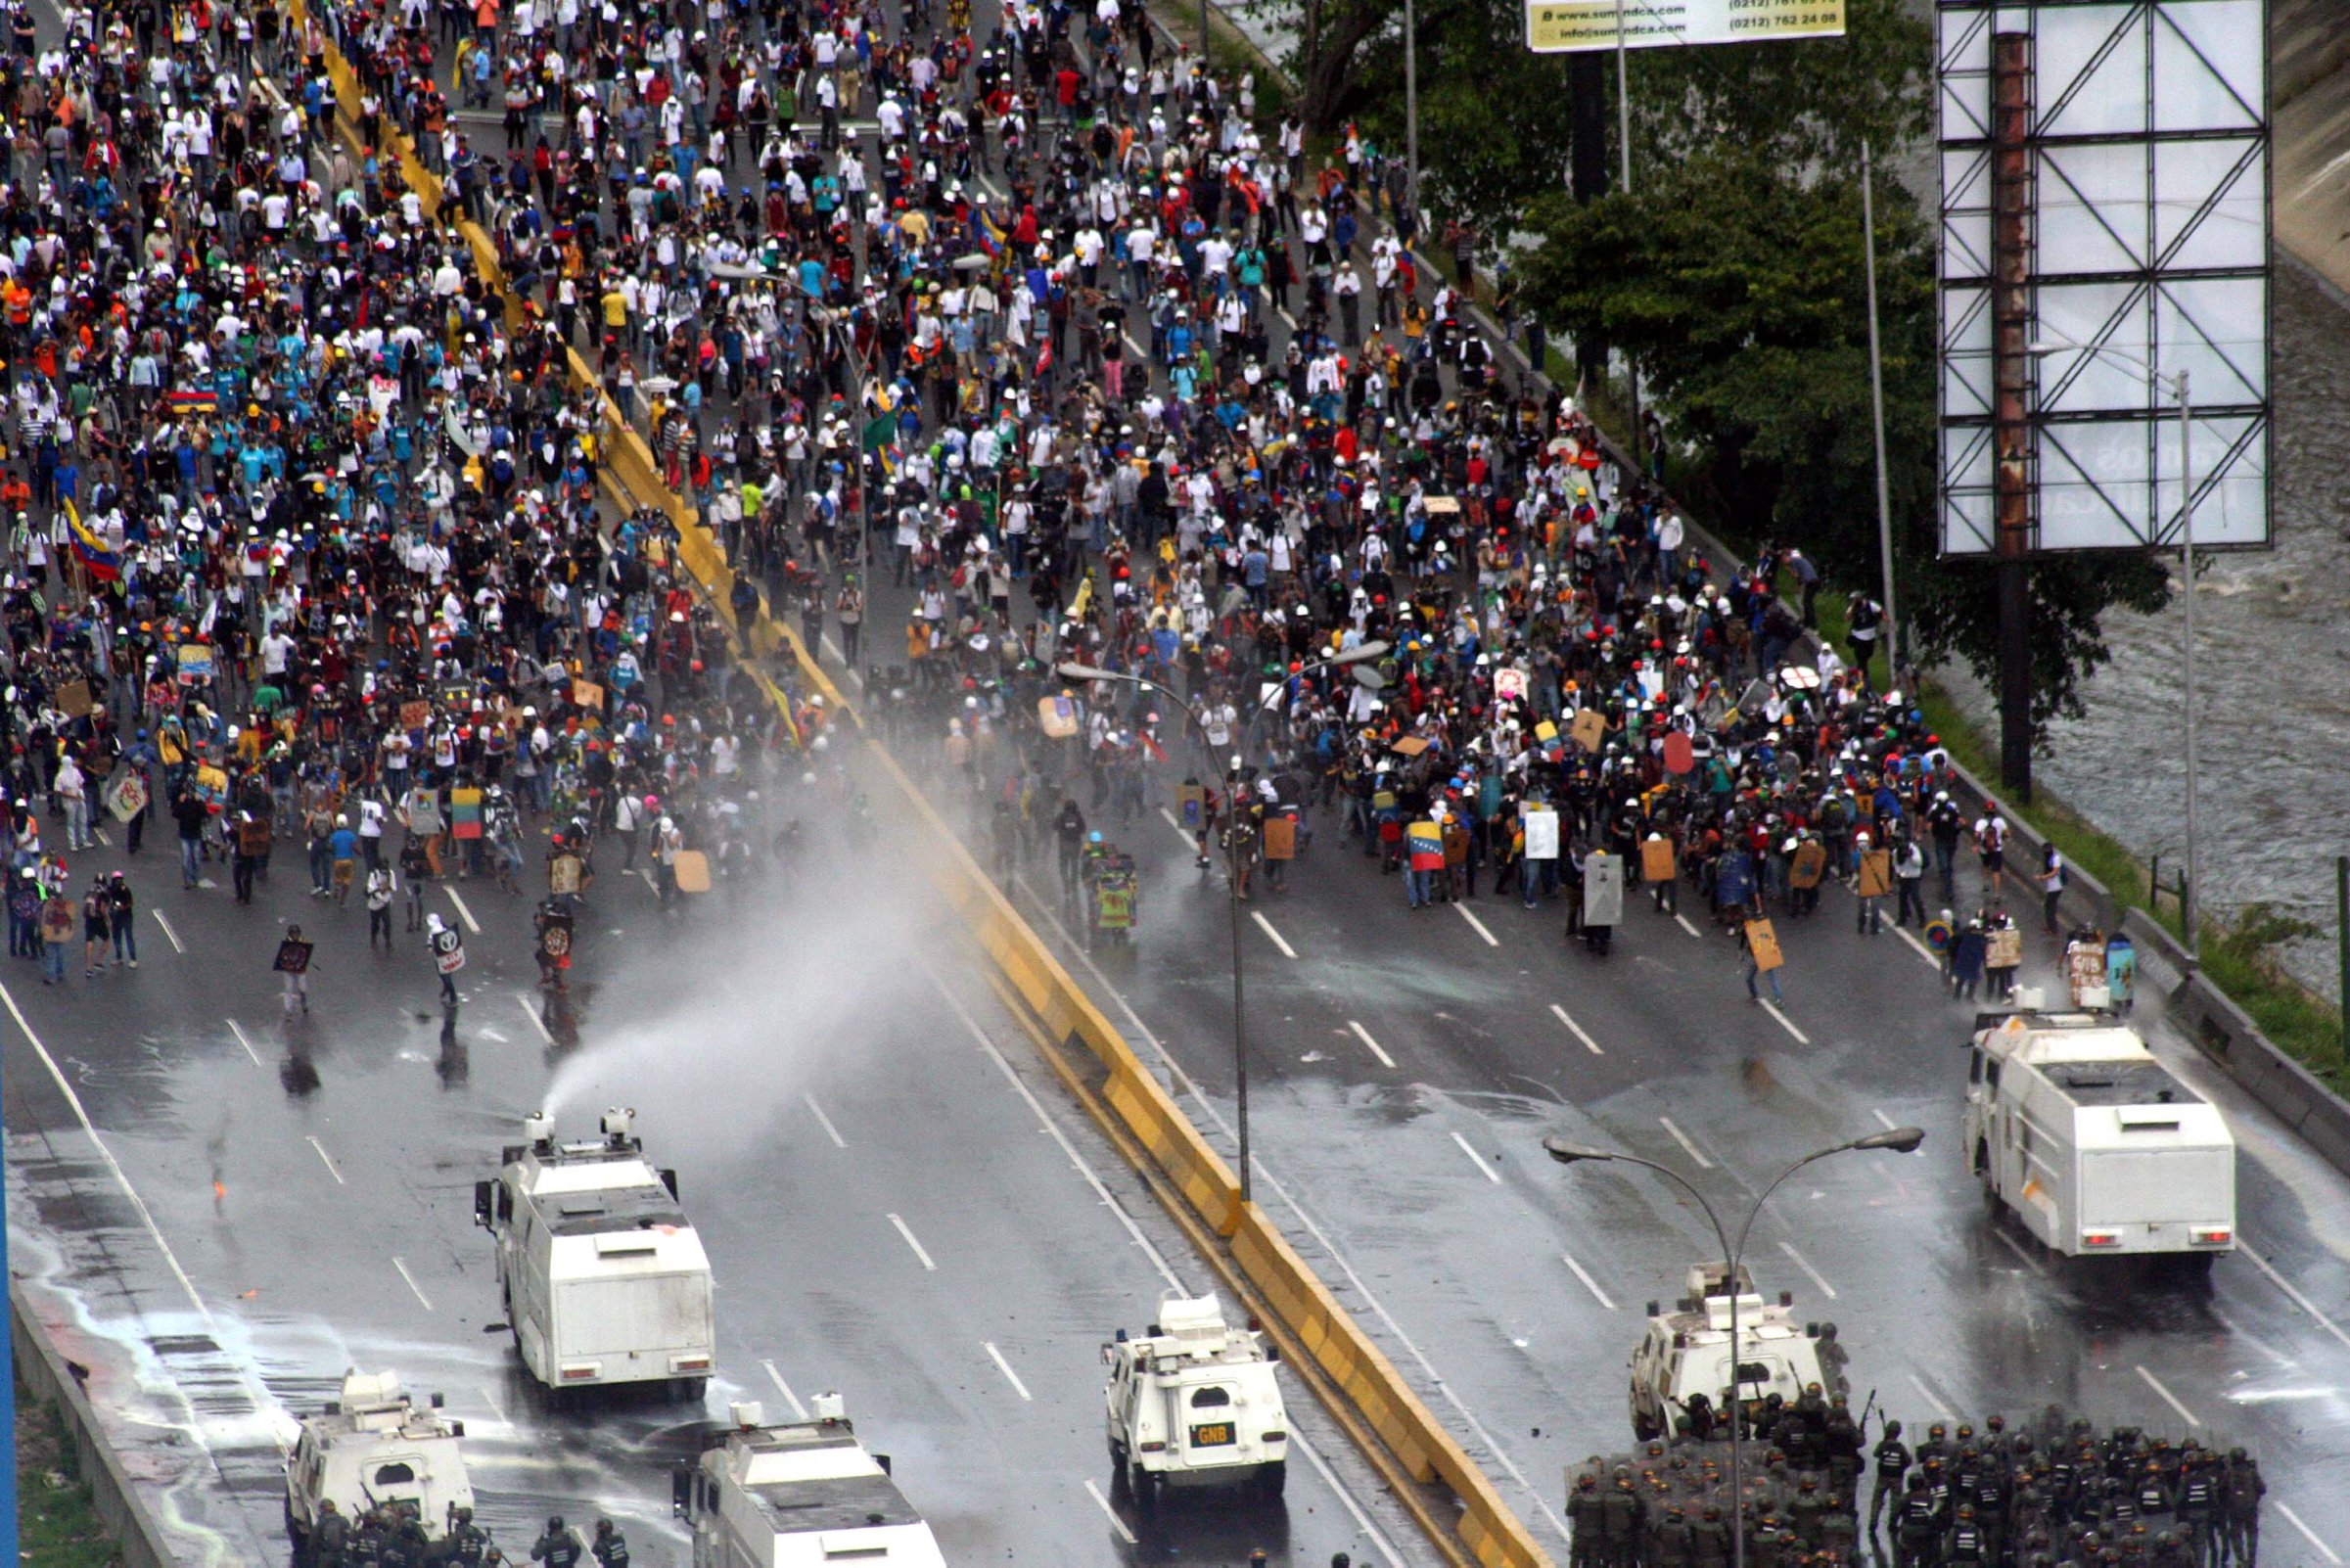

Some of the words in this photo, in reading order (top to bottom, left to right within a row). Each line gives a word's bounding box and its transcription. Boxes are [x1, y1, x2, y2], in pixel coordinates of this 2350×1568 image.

[1556, 6, 1685, 21] www.sumndca.com
[1729, 18, 1770, 30] (0212)
[1774, 16, 1797, 25] 762
[1802, 14, 1817, 24] 24
[1560, 24, 1685, 39] info@sumndca.com
[1199, 1425, 1226, 1444] GNB
